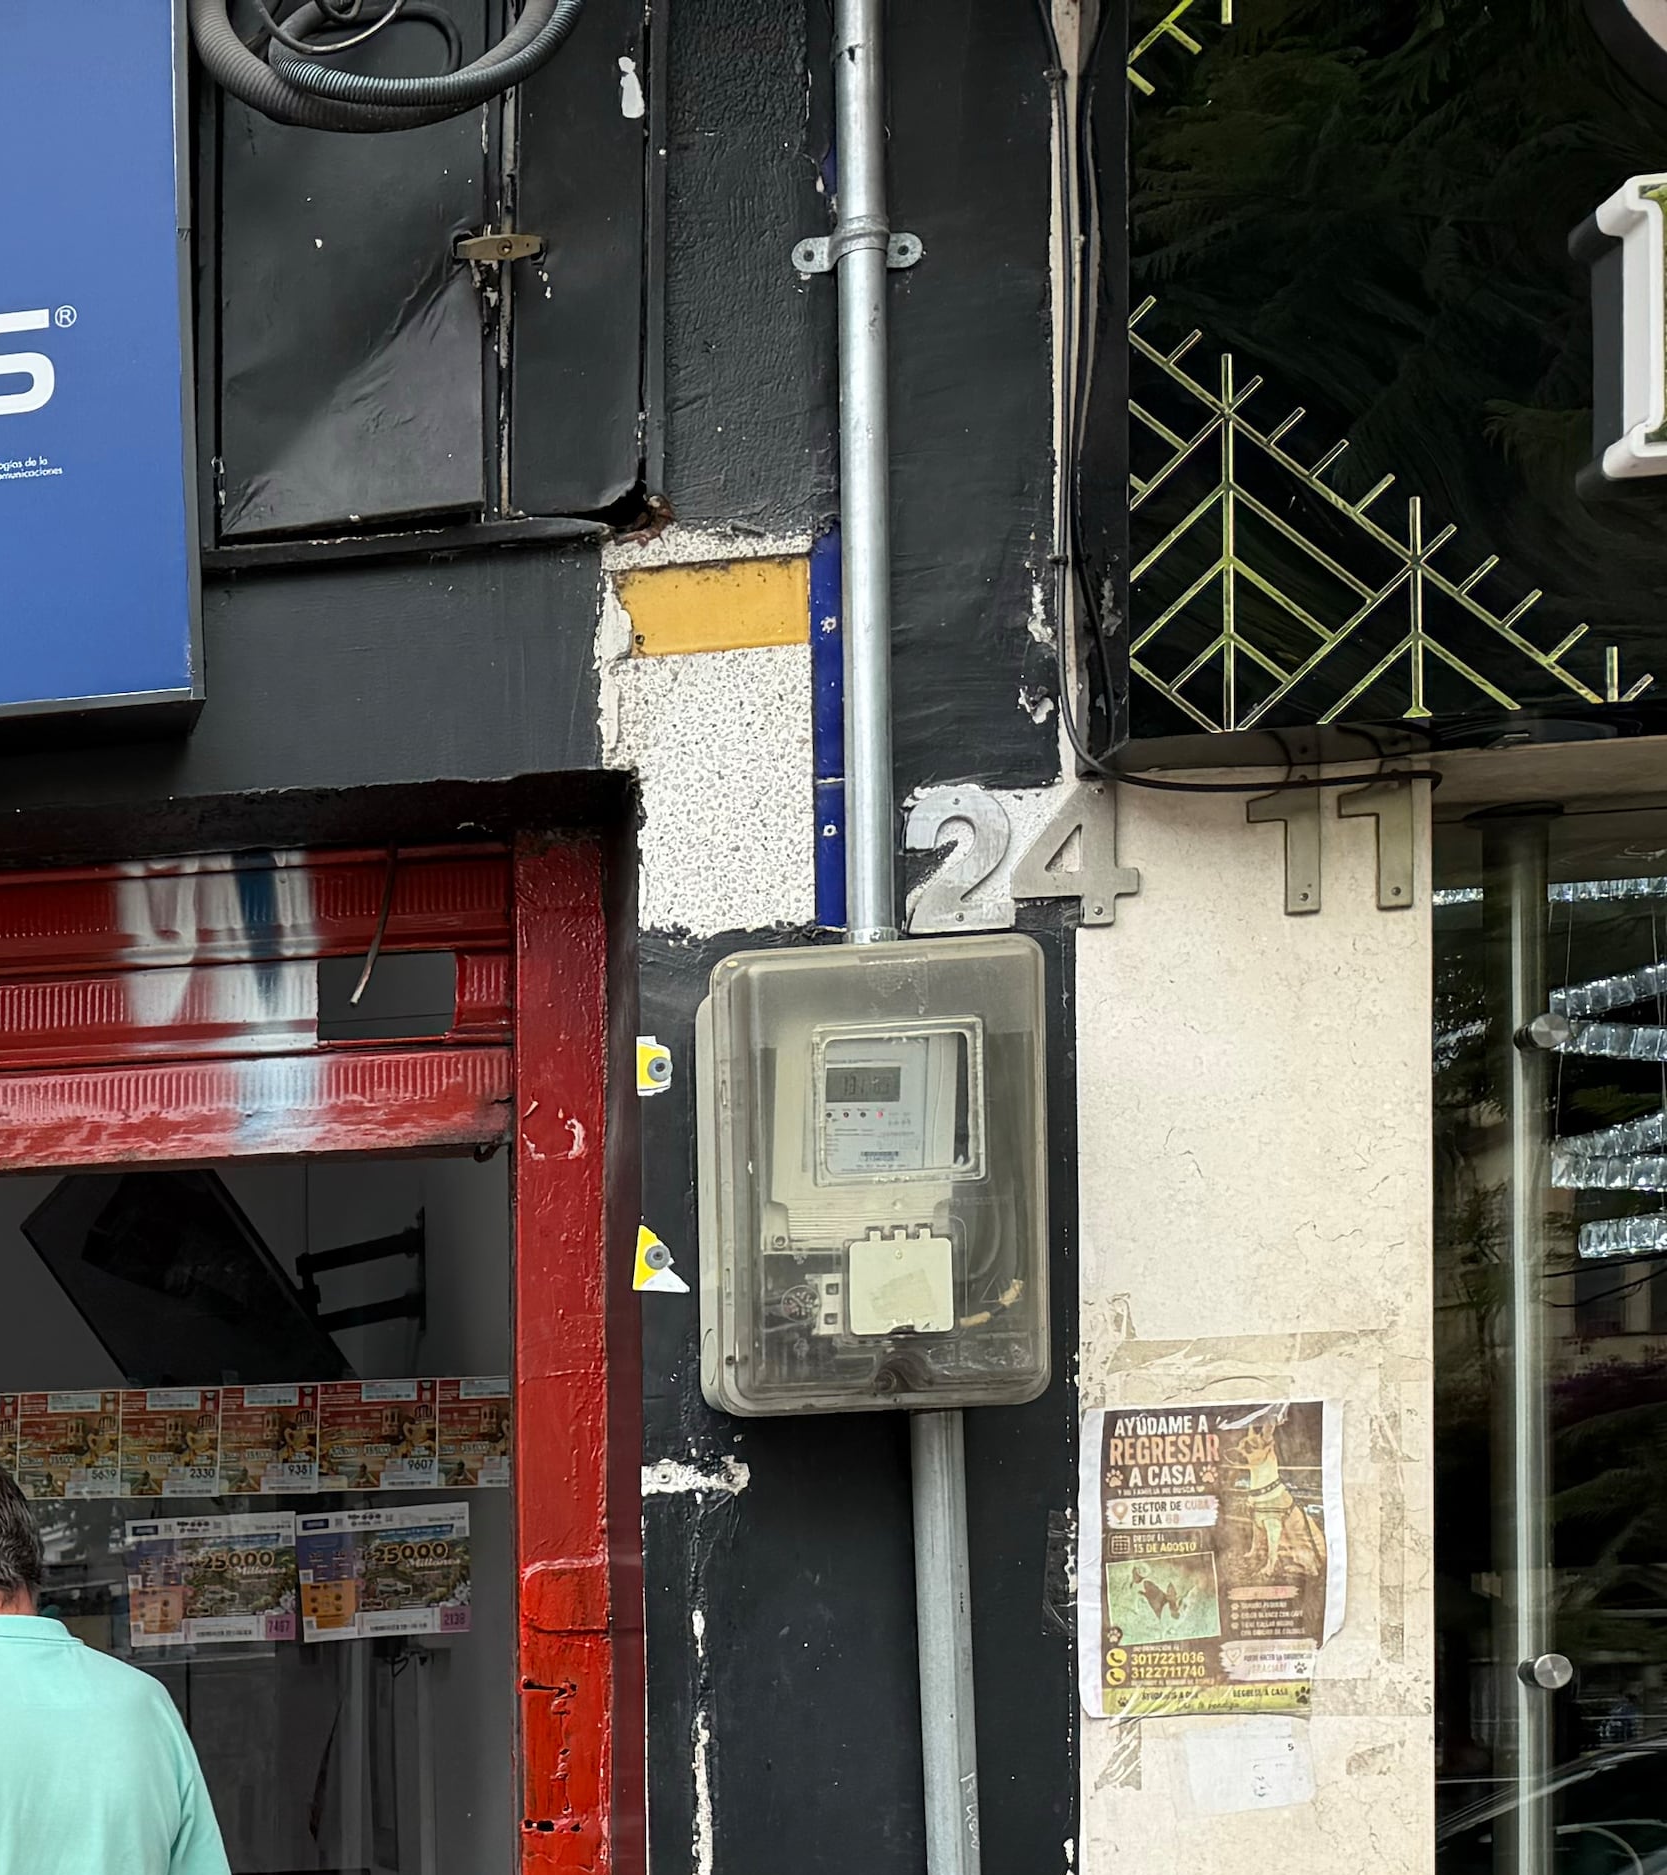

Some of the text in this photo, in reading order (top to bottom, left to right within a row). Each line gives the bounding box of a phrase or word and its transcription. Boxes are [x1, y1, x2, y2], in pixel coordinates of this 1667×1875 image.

[24, 456, 37, 468] de
[39, 456, 48, 466] la
[903, 779, 1140, 934] 24
[1197, 1414, 1209, 1433] A
[1109, 1434, 1220, 1466] REGRESAR
[407, 1458, 434, 1472] 9607
[189, 1467, 216, 1479] 2330
[1128, 1464, 1197, 1487] A CASA
[1131, 1500, 1167, 1513] SECTOR
[1169, 1500, 1182, 1511] DE
[1131, 1514, 1146, 1526] EN
[1149, 1513, 1163, 1526] LA
[1146, 1543, 1158, 1553] DE
[1159, 1541, 1197, 1553] AGOSTO
[1130, 1651, 1205, 1665] 3017221036
[1130, 1665, 1205, 1679] 3122711740
